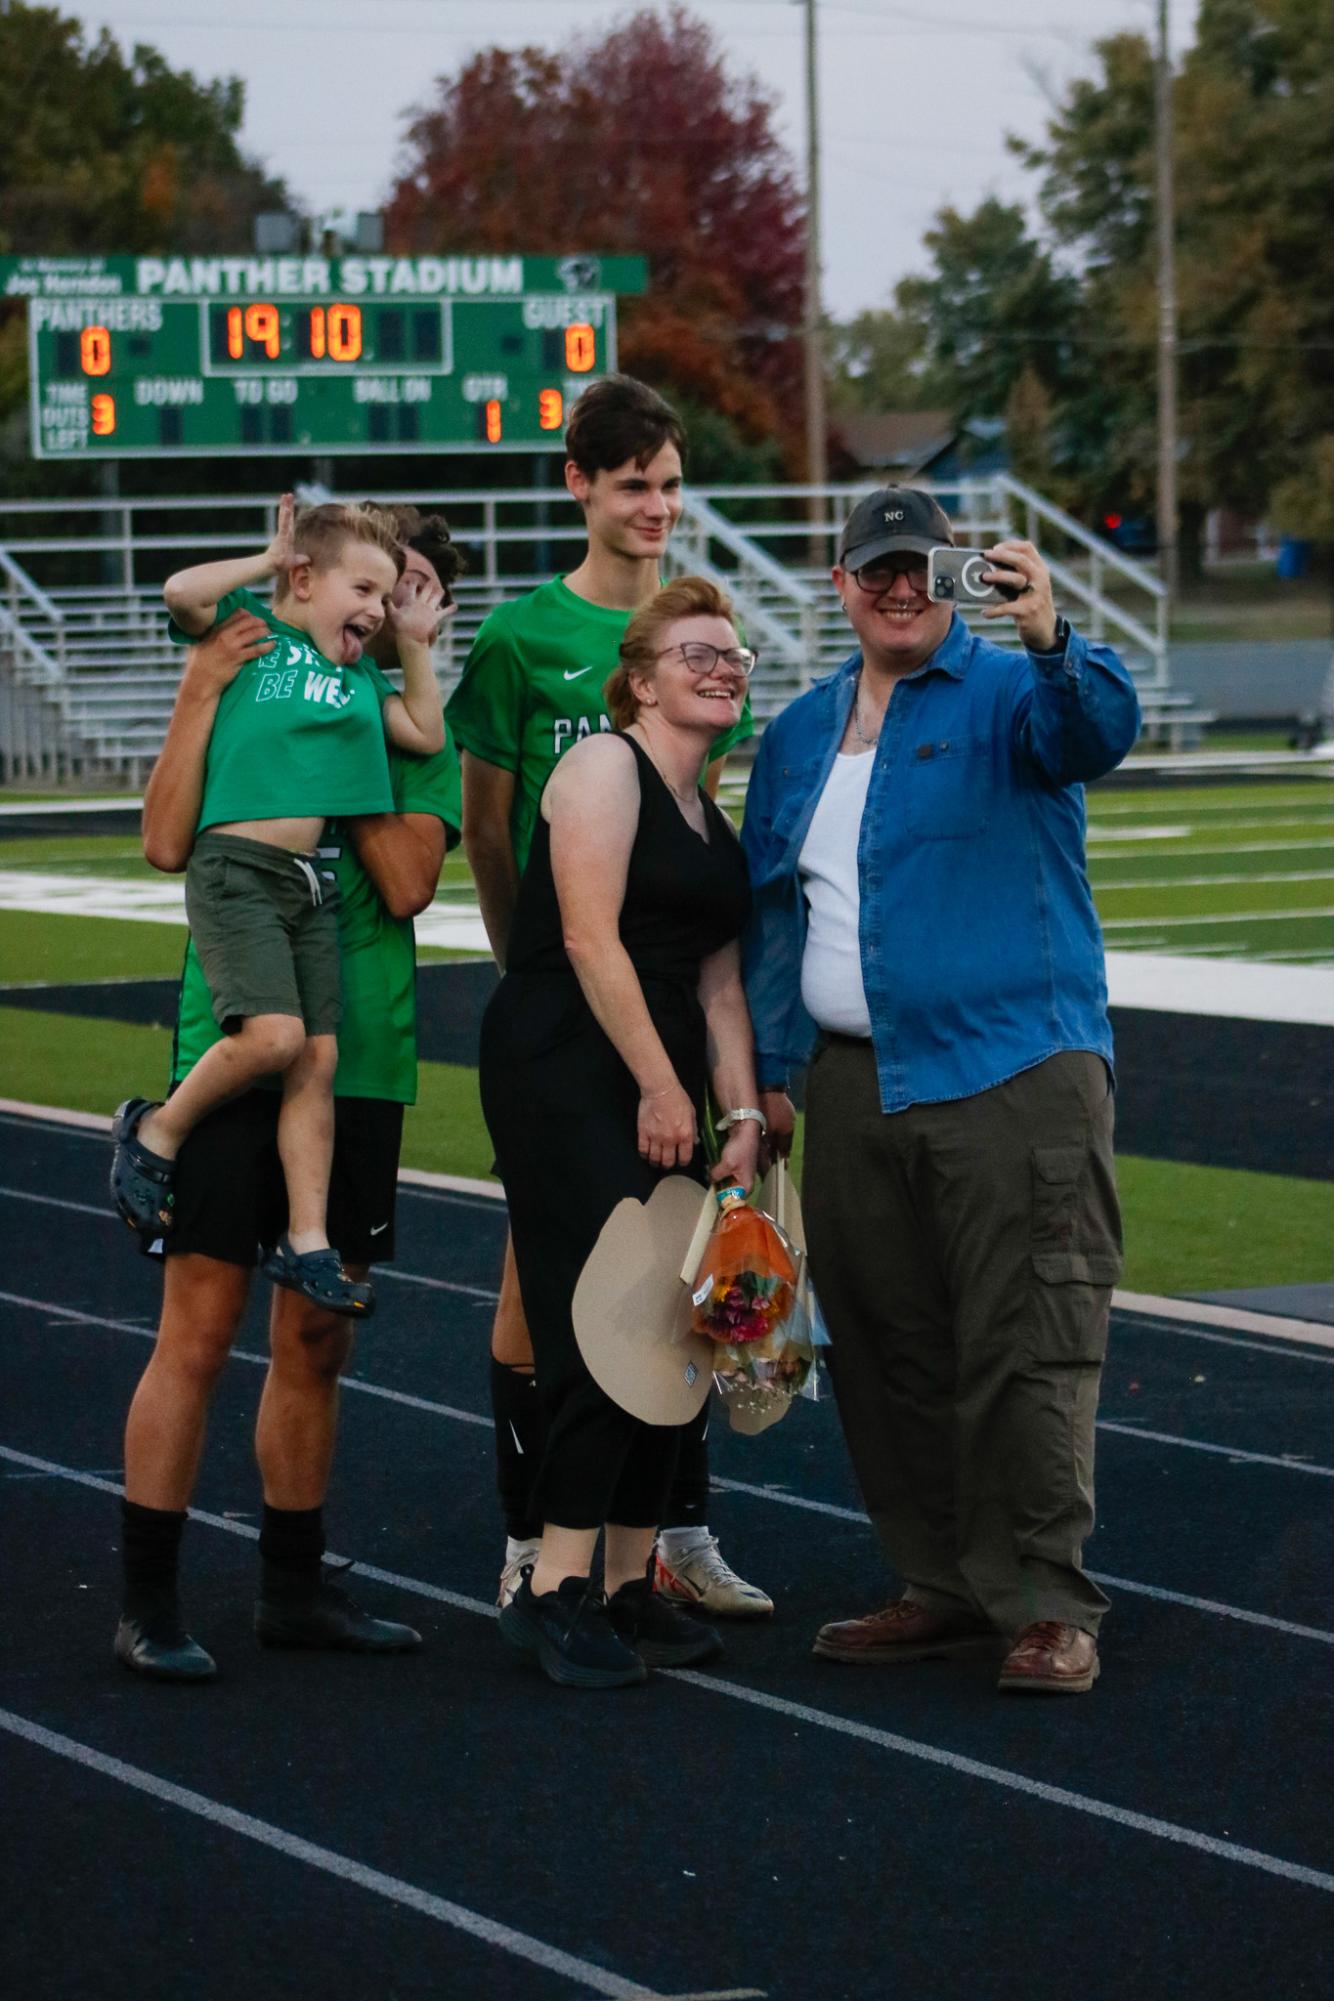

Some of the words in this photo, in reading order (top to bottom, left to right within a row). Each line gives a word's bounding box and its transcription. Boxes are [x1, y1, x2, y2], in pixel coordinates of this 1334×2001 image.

[136, 258, 331, 294] PANTHER
[340, 256, 524, 293] STADIUM
[35, 300, 163, 331] PANTHERS
[522, 300, 607, 329] GUEST
[80, 325, 111, 376] 0
[564, 323, 596, 372] 0
[134, 379, 204, 404] DOWN
[538, 388, 563, 430] 3
[91, 393, 116, 436] 3
[485, 399, 502, 443] 1
[884, 511, 904, 522] NC
[256, 669, 298, 702] BE
